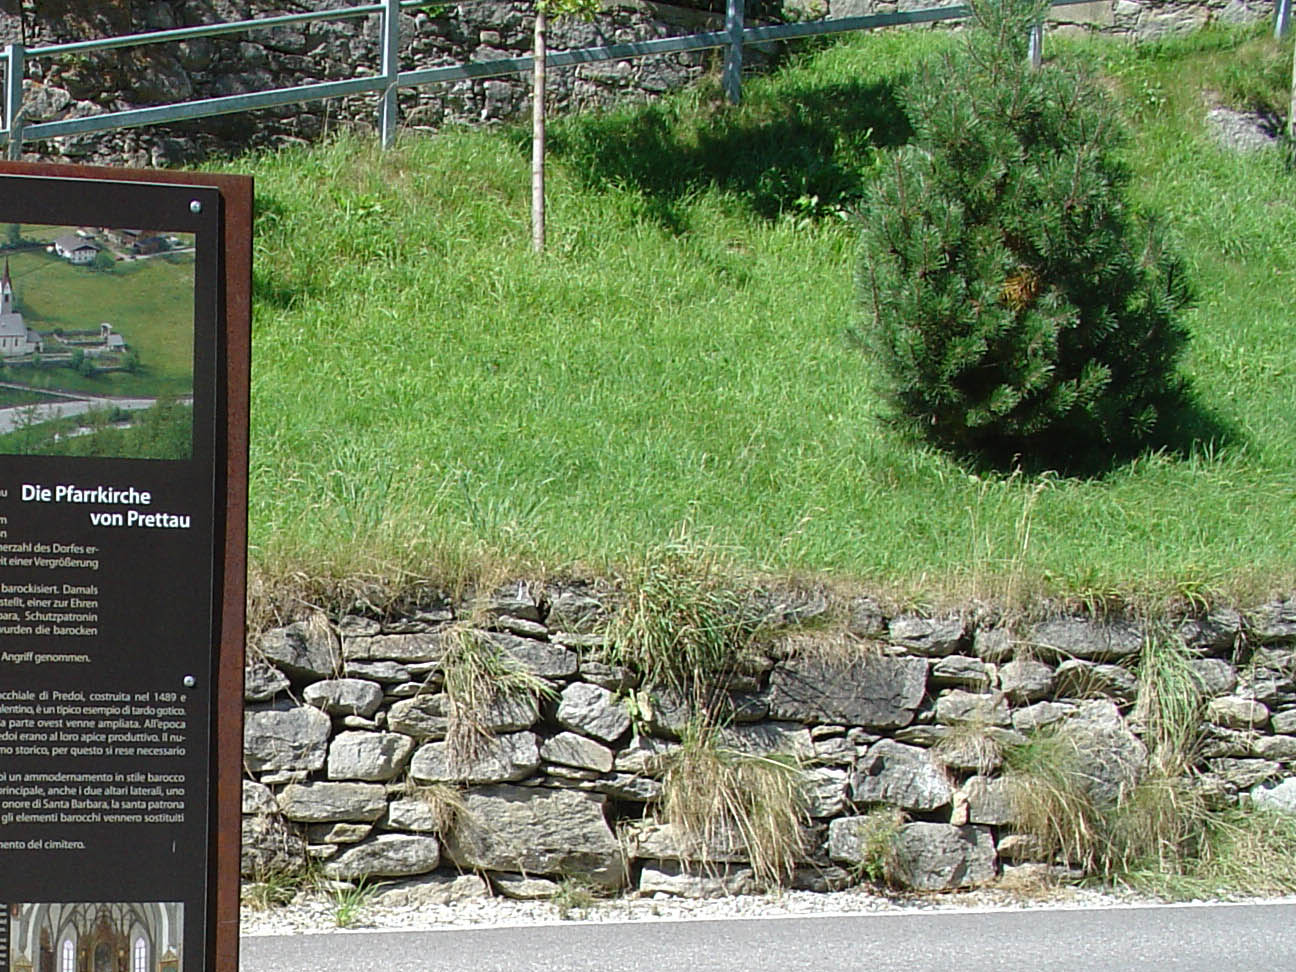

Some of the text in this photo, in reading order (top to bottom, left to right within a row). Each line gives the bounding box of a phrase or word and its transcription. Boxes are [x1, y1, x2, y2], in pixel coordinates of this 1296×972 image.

[21, 485, 151, 505] Die Pfarrkirche
[91, 510, 190, 528] von Prettau
[33, 543, 50, 553] des
[52, 543, 83, 553] Dorfes
[62, 585, 98, 595] Damals
[27, 598, 50, 607] einer
[70, 598, 98, 608] Ehren
[25, 611, 97, 623] Schutzpatronin
[35, 625, 49, 634] die
[53, 625, 97, 635] barocken
[39, 691, 48, 700] di
[89, 691, 130, 701] costruita
[134, 692, 149, 701] nel
[154, 692, 176, 701] 1489
[9, 718, 34, 729] parte
[37, 718, 62, 728] ovest
[98, 719, 141, 730] ampliata.
[23, 772, 112, 782] ammodernamento
[114, 772, 123, 782] in
[126, 773, 144, 782] stile
[147, 773, 185, 782] barocco
[1, 813, 13, 824] gli
[16, 813, 57, 822] elementi
[60, 813, 100, 822] barocchi
[144, 813, 184, 822] sostituiti
